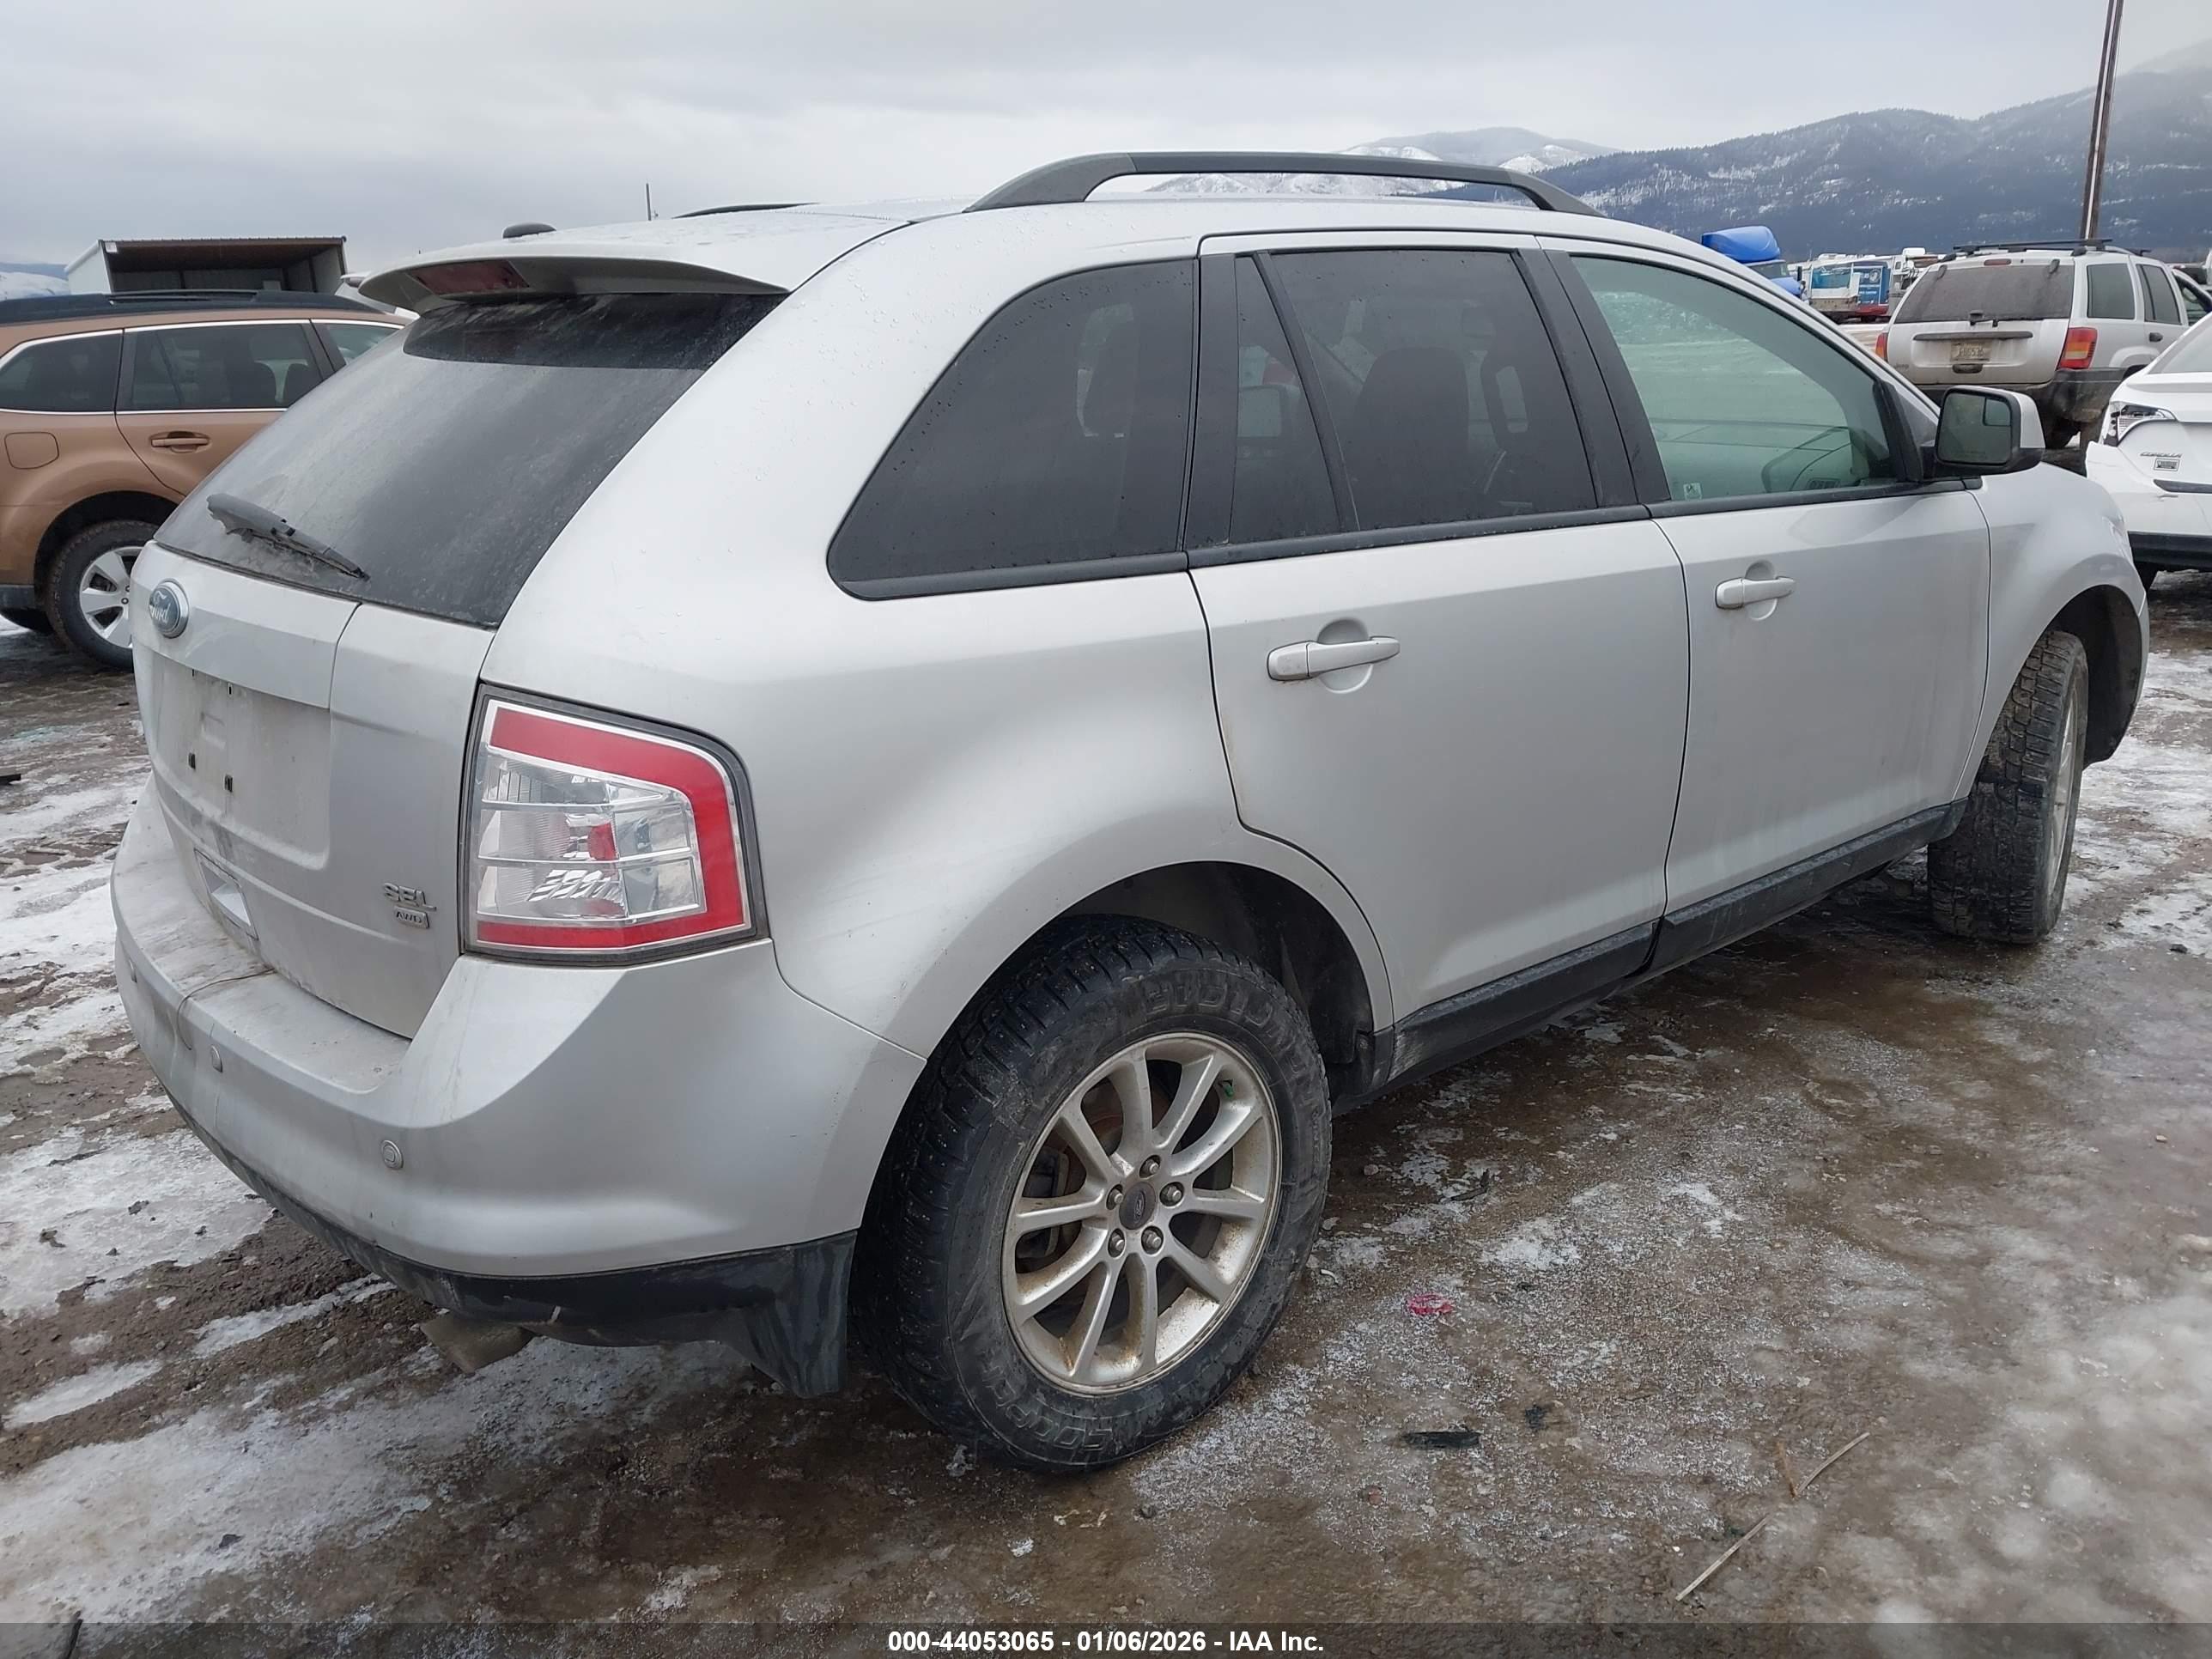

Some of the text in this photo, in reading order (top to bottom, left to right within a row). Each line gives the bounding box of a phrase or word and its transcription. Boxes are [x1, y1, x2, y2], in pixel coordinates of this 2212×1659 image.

[149, 590, 172, 624] Ford
[383, 882, 436, 911] SEL
[396, 910, 423, 925] AWD
